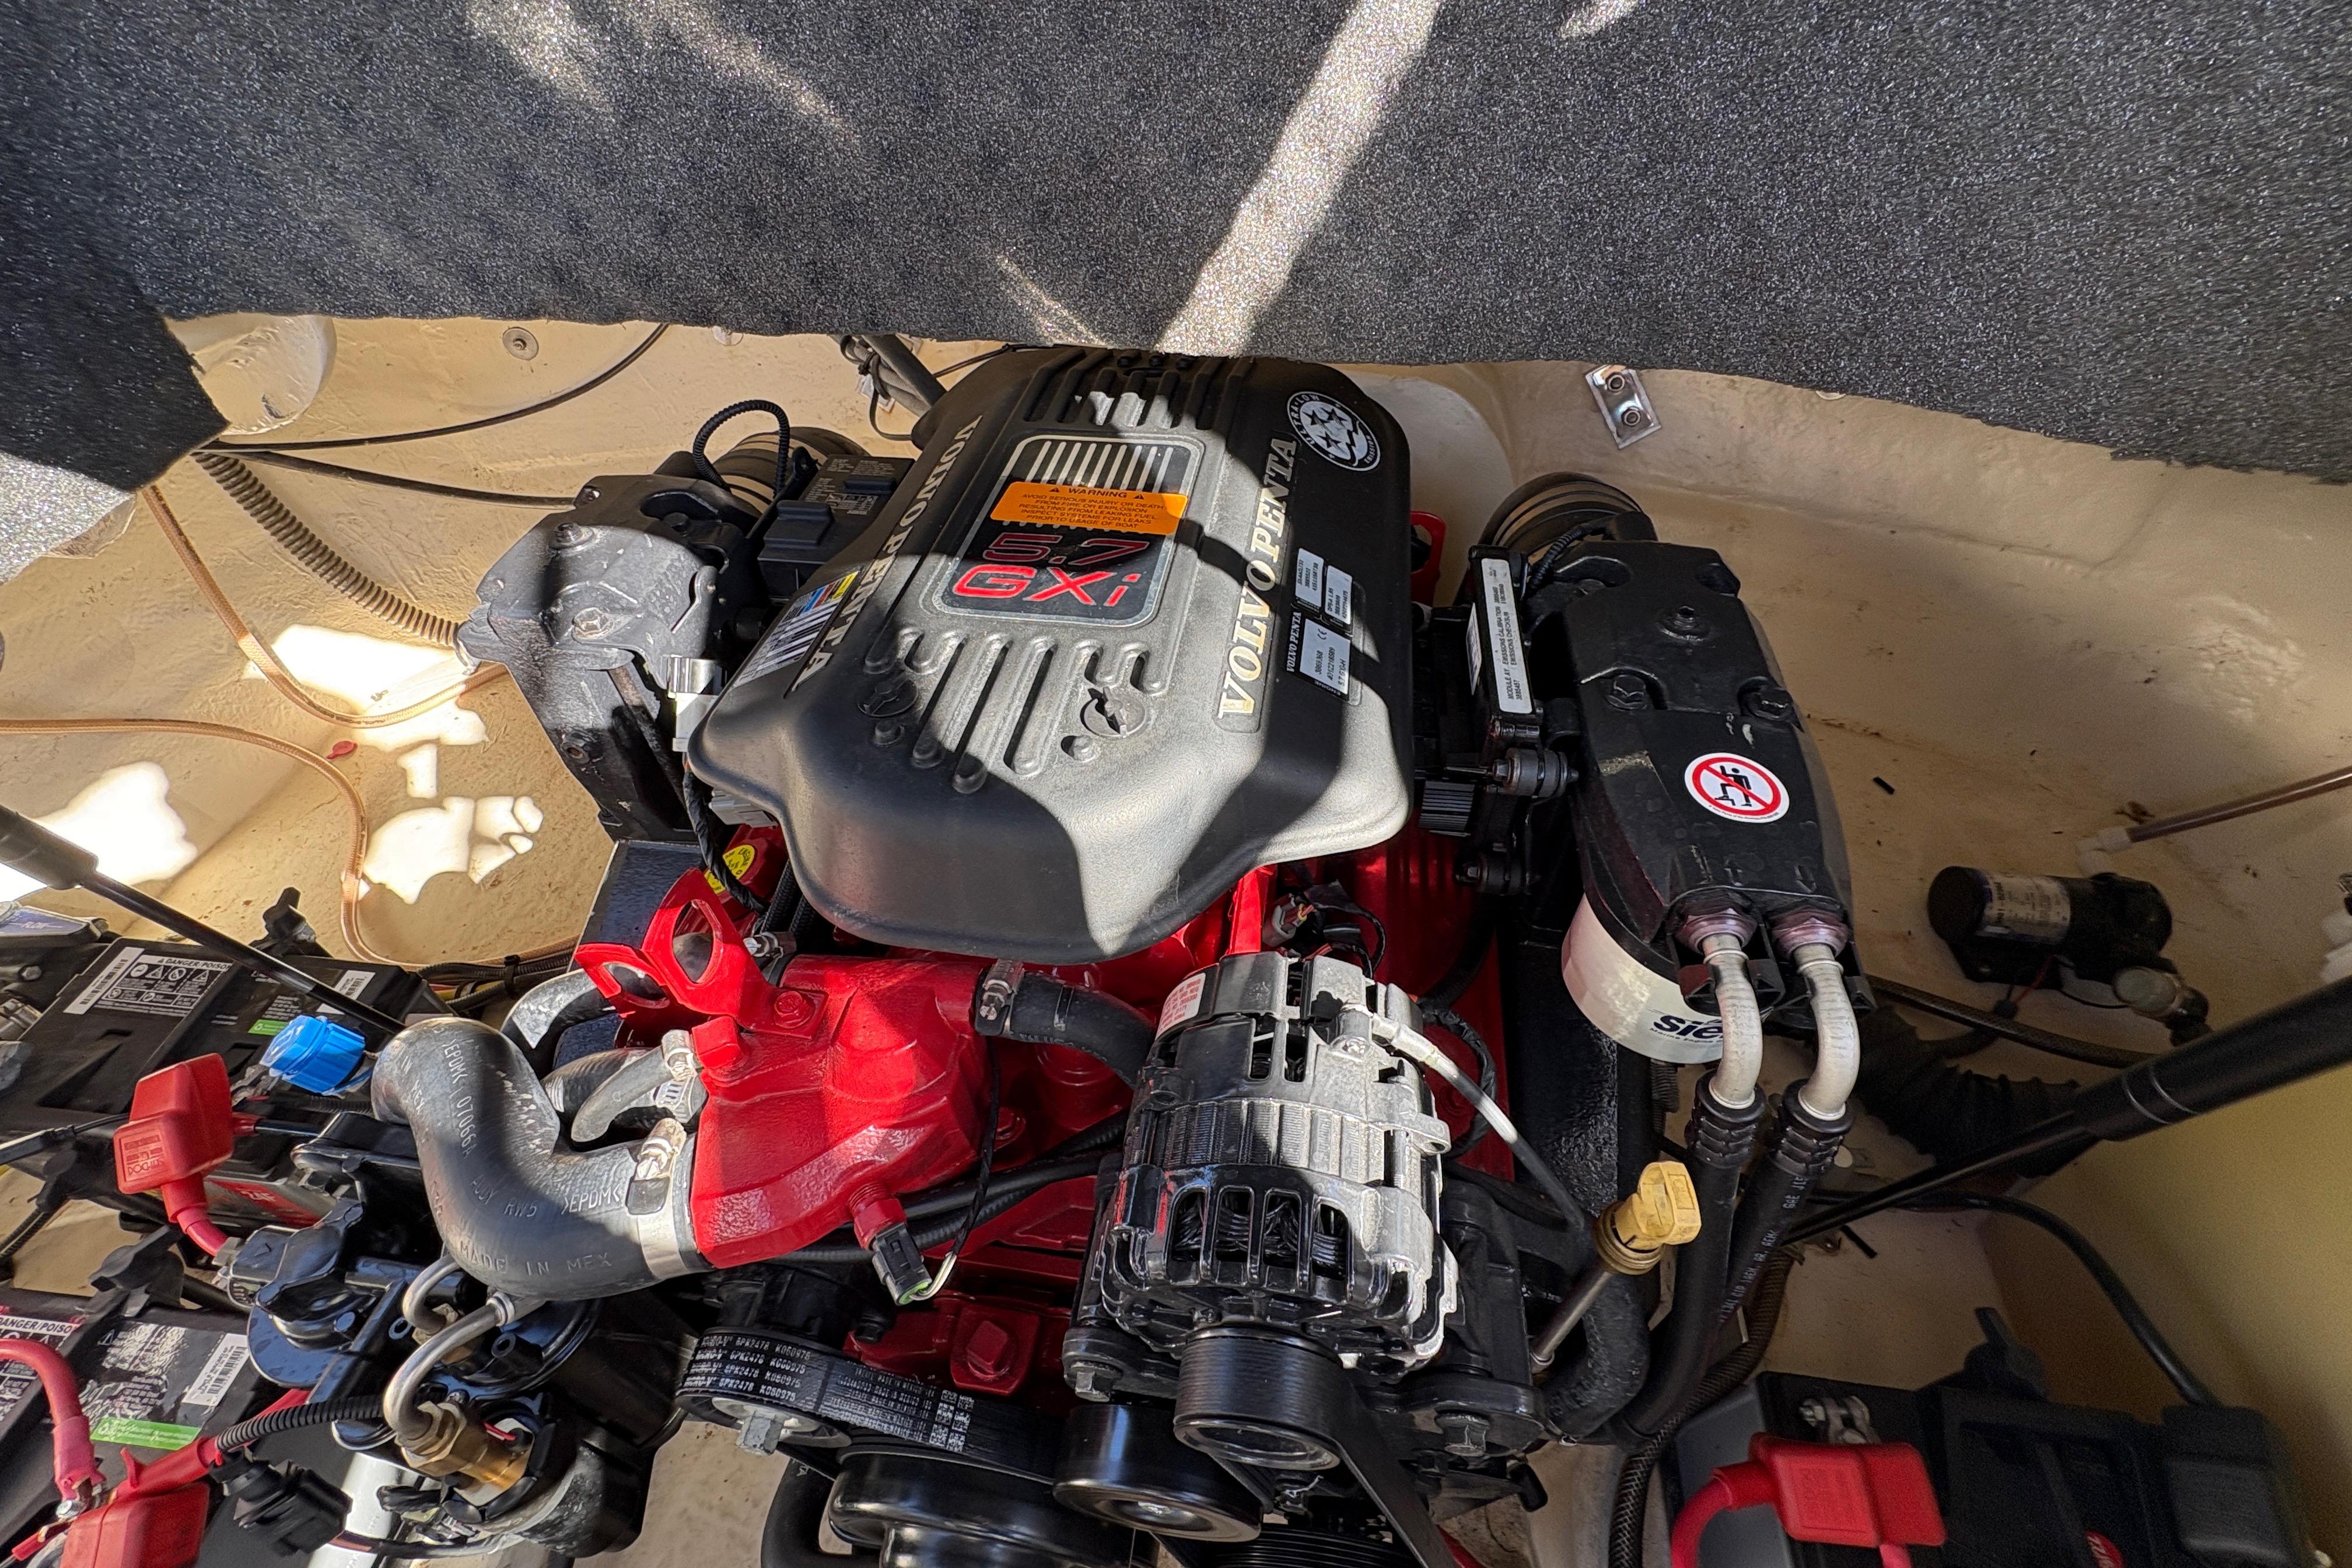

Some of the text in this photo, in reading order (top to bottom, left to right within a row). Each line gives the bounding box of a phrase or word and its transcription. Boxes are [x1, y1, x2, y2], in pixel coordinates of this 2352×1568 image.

[900, 415, 983, 527] VOLVO
[1049, 495, 1087, 503] SERIOUS
[1069, 488, 1128, 498] WARNING
[1097, 505, 1149, 513] EXPLOSION
[982, 532, 1150, 566] 5.7
[953, 564, 1142, 607] GXi
[1217, 439, 1297, 719] VOLVO PENTA
[791, 526, 914, 691] PENTA
[1287, 612, 1301, 672] VOLVO PENTA
[1504, 677, 1514, 700] MODULE
[1654, 1015, 1723, 1039] sie
[460, 1240, 611, 1276] MADE IN MEX
